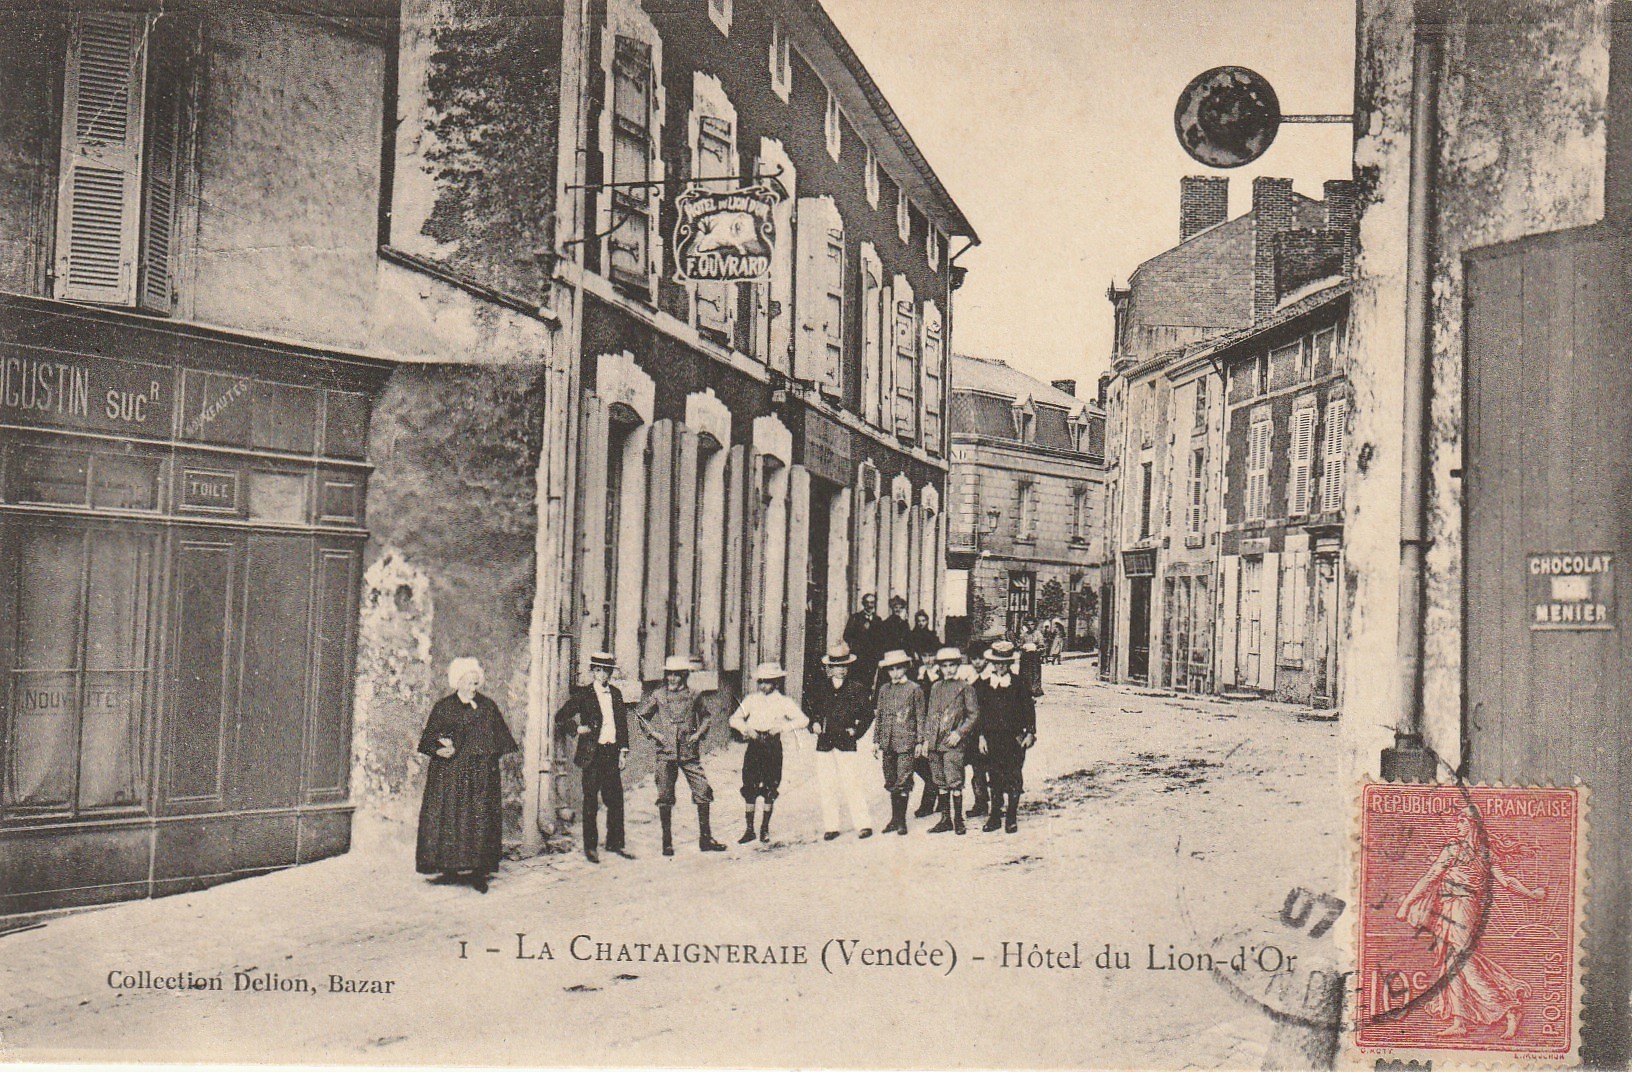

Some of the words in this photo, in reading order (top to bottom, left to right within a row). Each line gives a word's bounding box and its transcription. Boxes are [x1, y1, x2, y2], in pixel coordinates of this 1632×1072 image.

[1530, 556, 1612, 575] CHOCOLAT
[1536, 604, 1607, 622] MENIER
[1486, 798, 1568, 818] FRANÇAISE
[1542, 952, 1562, 1034] POSTES
